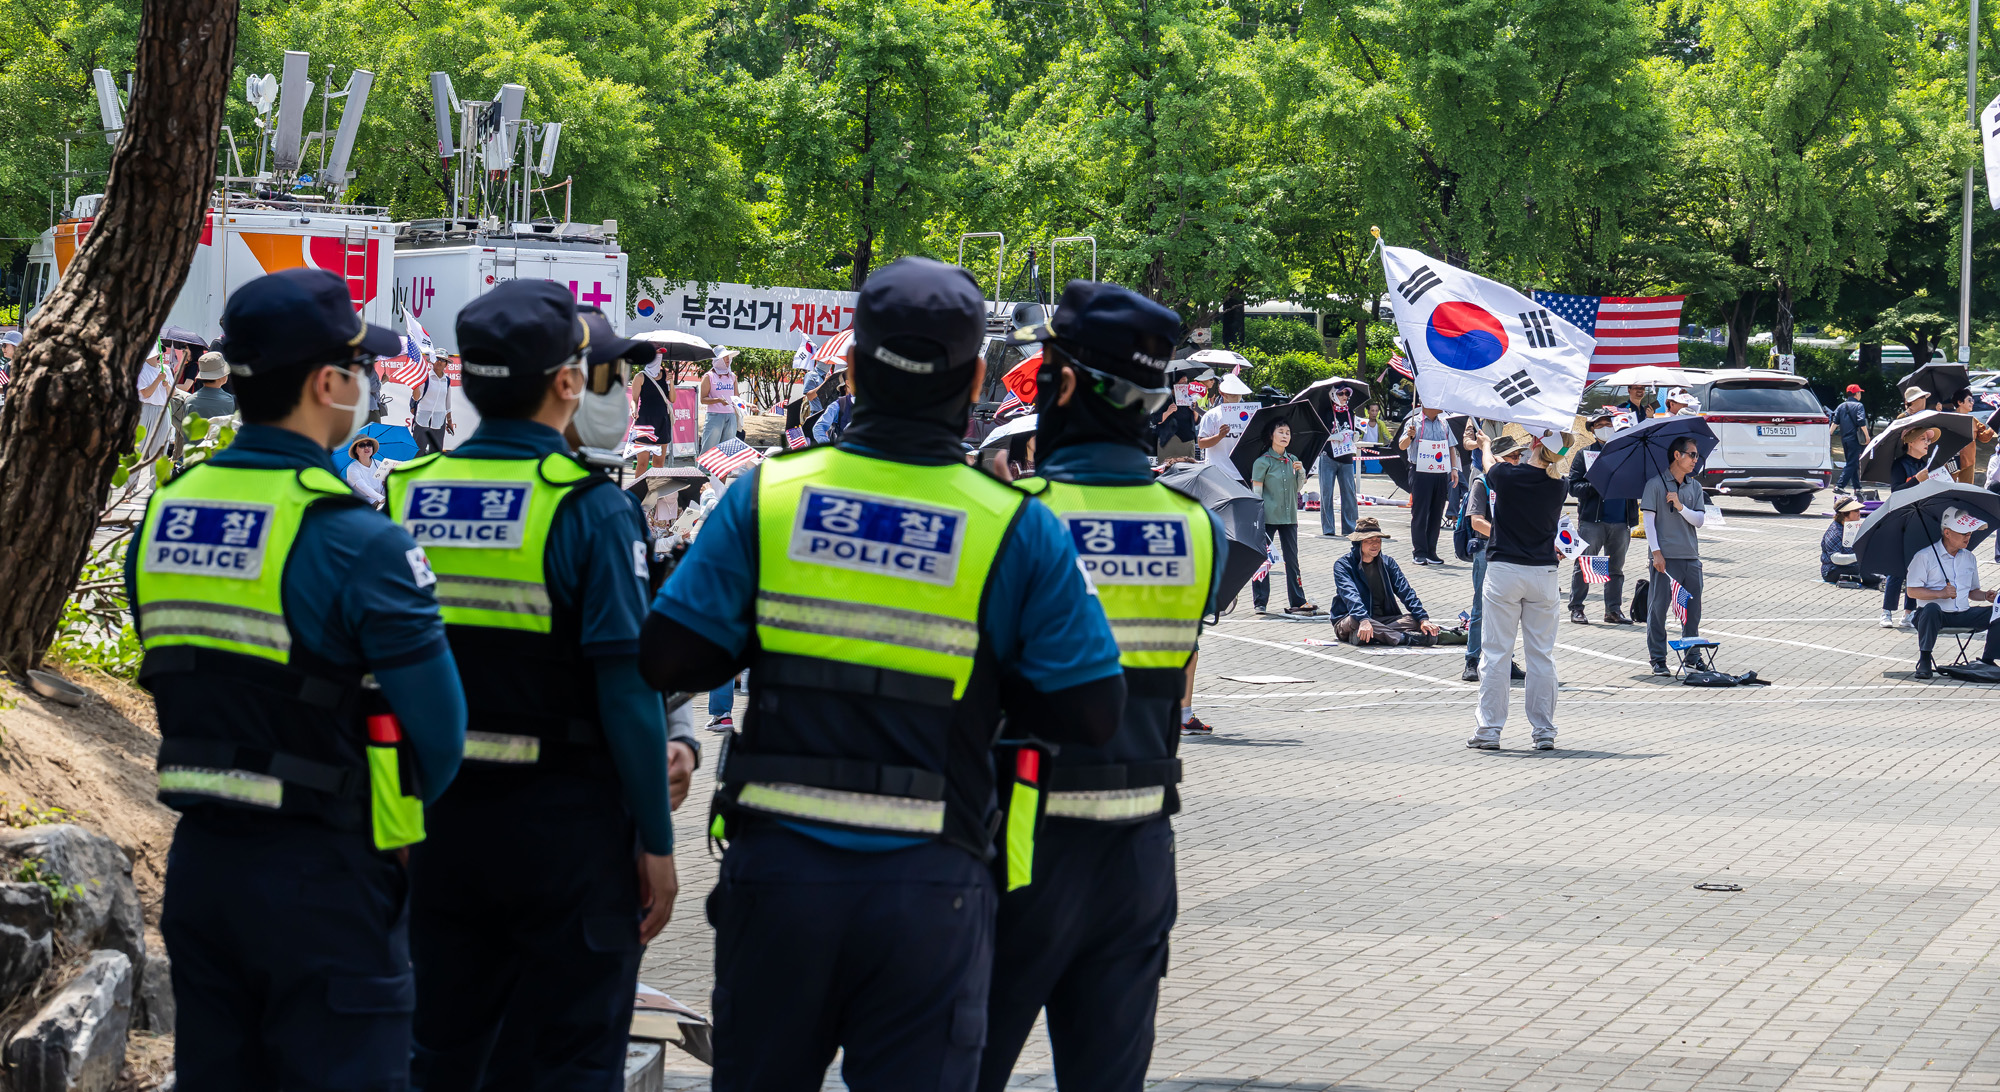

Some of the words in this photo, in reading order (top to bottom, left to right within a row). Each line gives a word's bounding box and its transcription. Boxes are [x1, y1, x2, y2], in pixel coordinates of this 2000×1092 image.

[412, 276, 435, 318] U+
[681, 295, 782, 333] 부정선거
[1189, 384, 1206, 395] 재선거
[1779, 427, 1794, 435] 5211
[412, 523, 509, 541] POLICE
[157, 547, 248, 569] POLICE
[810, 537, 937, 574] POLICE
[1084, 560, 1179, 577] POLICE
